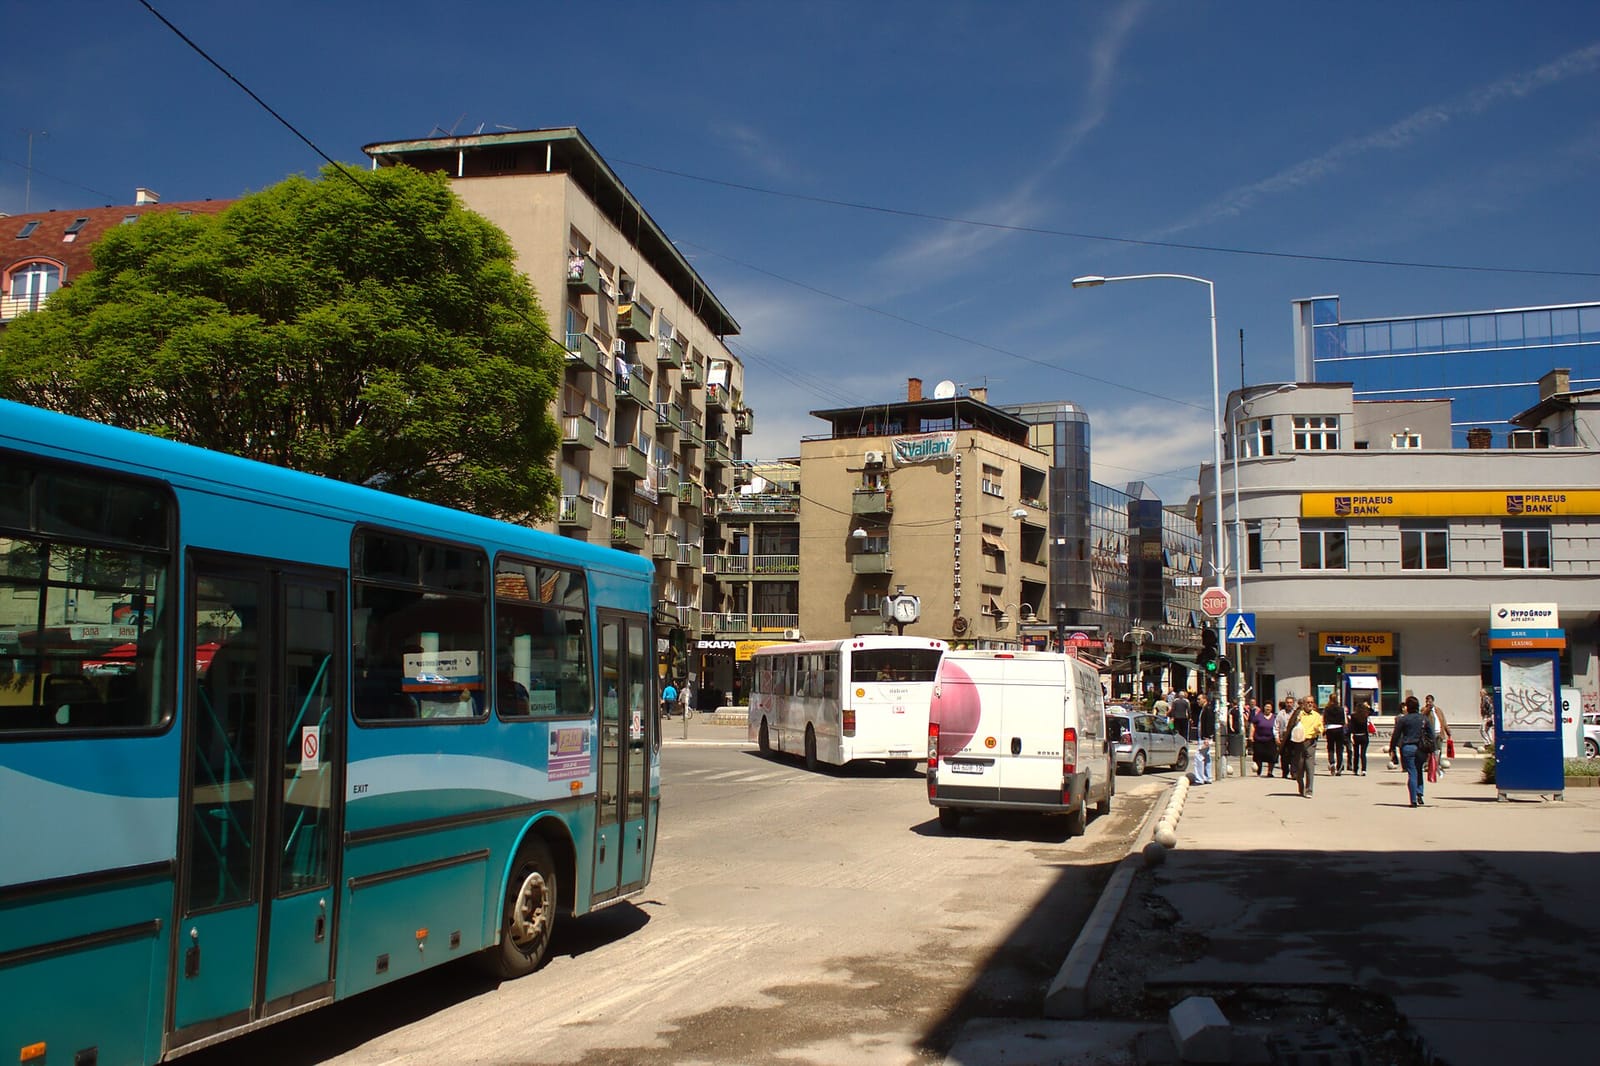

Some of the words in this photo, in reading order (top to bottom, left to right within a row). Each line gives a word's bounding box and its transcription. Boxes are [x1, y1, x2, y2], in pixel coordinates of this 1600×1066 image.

[907, 438, 952, 457] Vaillant
[1352, 496, 1393, 504] PIRAEUS
[1525, 495, 1566, 503] PIRAEUS
[1353, 506, 1380, 514] BANK
[1525, 505, 1552, 513] BANK
[1203, 598, 1226, 609] STOP
[1345, 635, 1385, 644] PIRAEUS
[353, 784, 369, 794] EXIT
